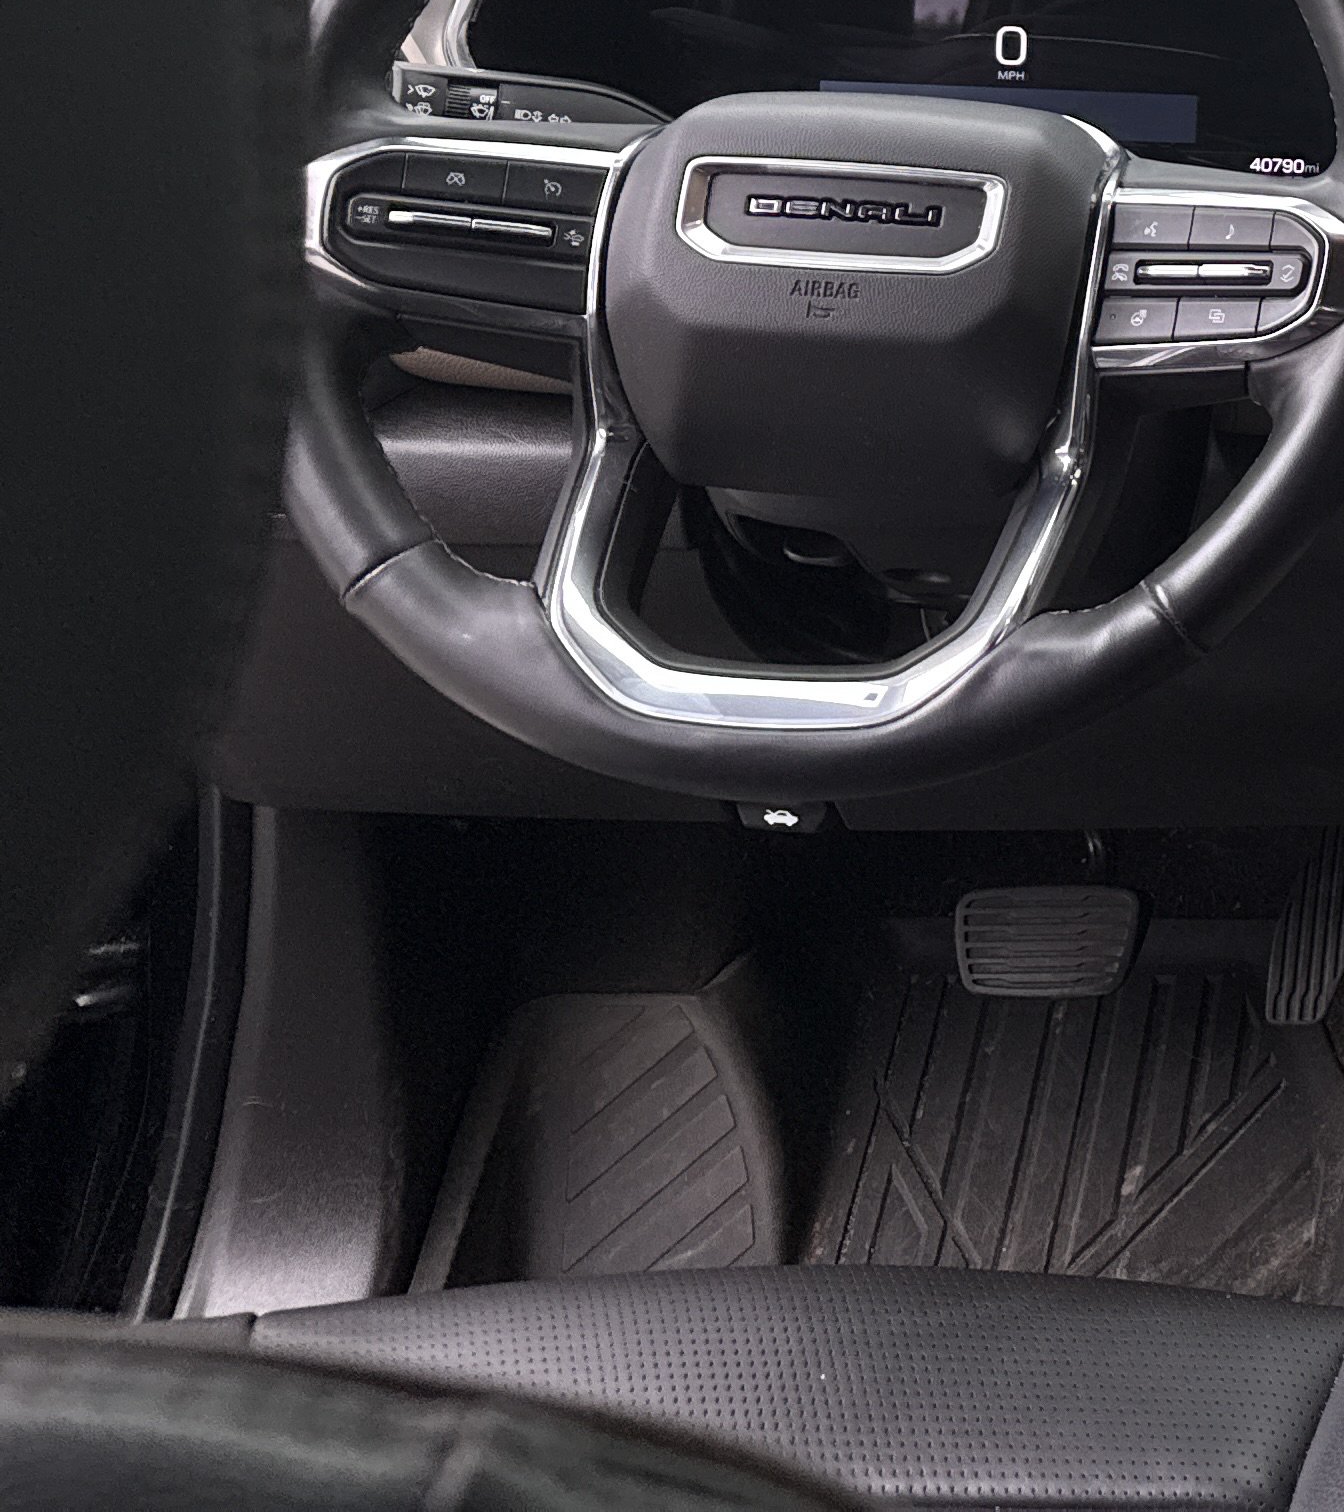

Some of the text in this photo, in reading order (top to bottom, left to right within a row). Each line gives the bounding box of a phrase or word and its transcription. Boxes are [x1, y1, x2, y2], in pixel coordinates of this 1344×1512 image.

[995, 25, 1027, 66] 0
[997, 70, 1026, 81] MPH
[746, 195, 946, 228] DENALI
[789, 279, 860, 299] AIRBAG
